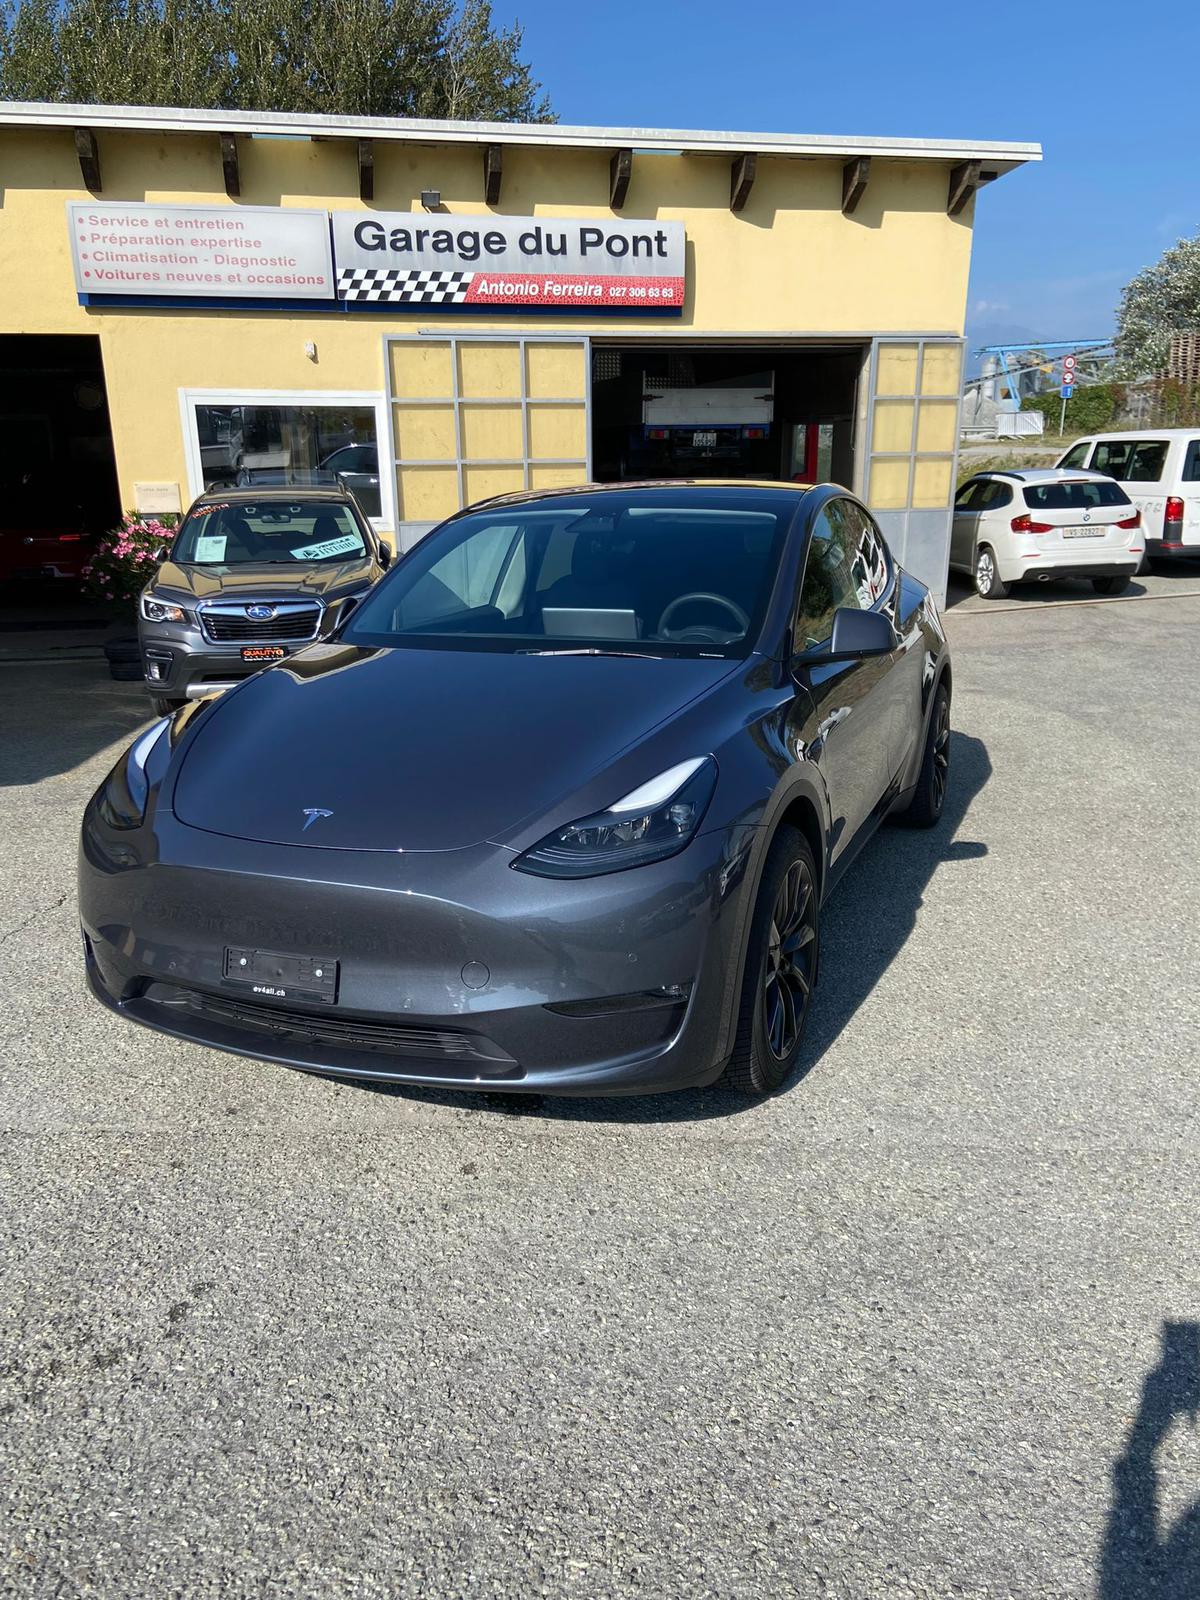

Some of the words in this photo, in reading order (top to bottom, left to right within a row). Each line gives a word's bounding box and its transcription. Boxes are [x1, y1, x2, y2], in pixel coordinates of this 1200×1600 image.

[88, 215, 149, 228] Service
[154, 218, 169, 229] et
[175, 218, 244, 231] entretien
[90, 233, 185, 247] Préparation
[190, 237, 262, 250] expertise
[353, 220, 507, 261] Garage
[519, 226, 568, 256] du
[580, 227, 668, 258] Pont
[93, 251, 198, 265] Climatisation
[213, 254, 297, 269] Diagnostic
[94, 269, 161, 282] Voitures
[166, 271, 223, 283] neuves
[227, 272, 241, 283] et
[247, 273, 325, 286] occasions
[477, 280, 539, 296] Antonio
[543, 281, 603, 297] Ferreira
[609, 288, 626, 297] 027
[628, 288, 646, 298] 306
[648, 288, 660, 298] 63
[661, 288, 673, 298] 63
[252, 986, 286, 997] ev4all.ch
